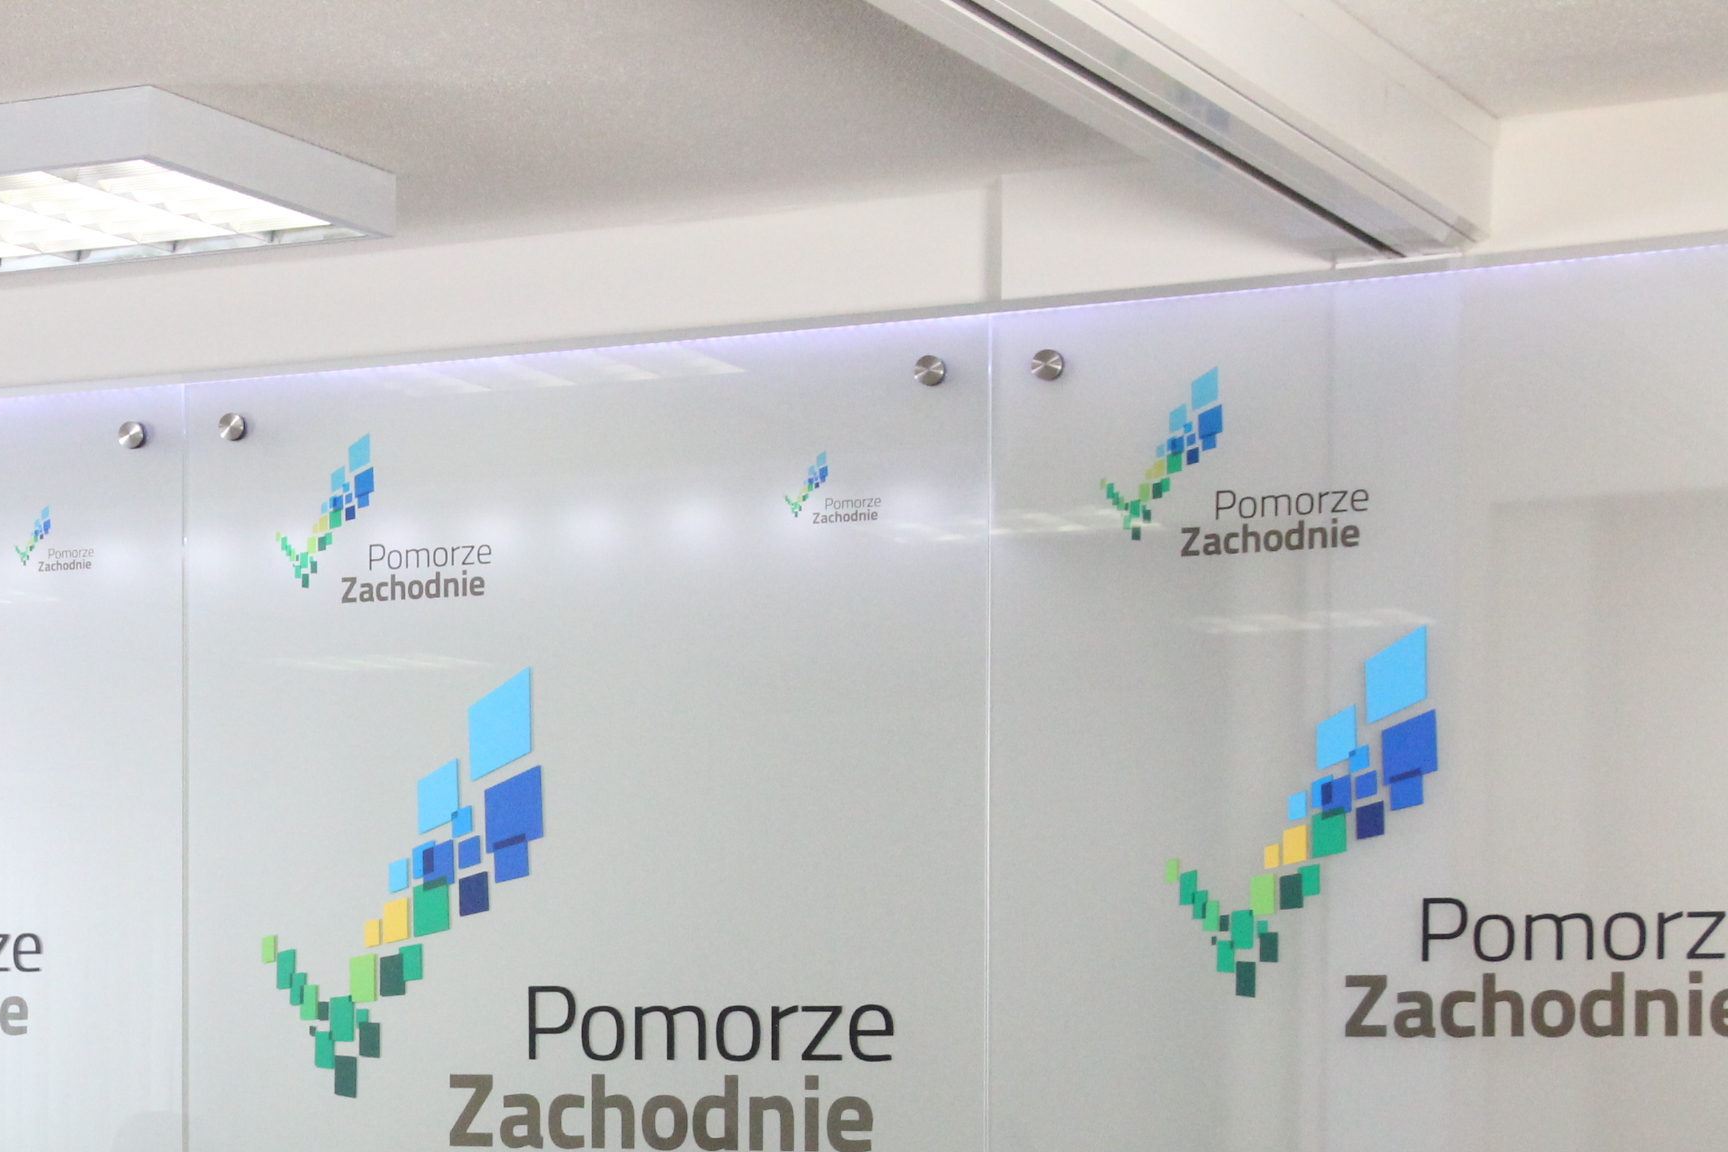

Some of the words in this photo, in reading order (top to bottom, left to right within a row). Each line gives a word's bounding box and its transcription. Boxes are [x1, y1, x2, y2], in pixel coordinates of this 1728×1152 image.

[812, 509, 879, 525] Zachodnie
[824, 495, 882, 511] Pomorze
[1214, 484, 1370, 520] Pomorze
[48, 546, 95, 560] Pomorze
[1180, 520, 1361, 558] Zachodnie
[37, 558, 93, 571] Zachodnie
[367, 540, 492, 570] Pomorze
[341, 571, 485, 603] Zachodnie
[1422, 896, 1727, 963] Pomorz
[526, 985, 895, 1063] Pomorze
